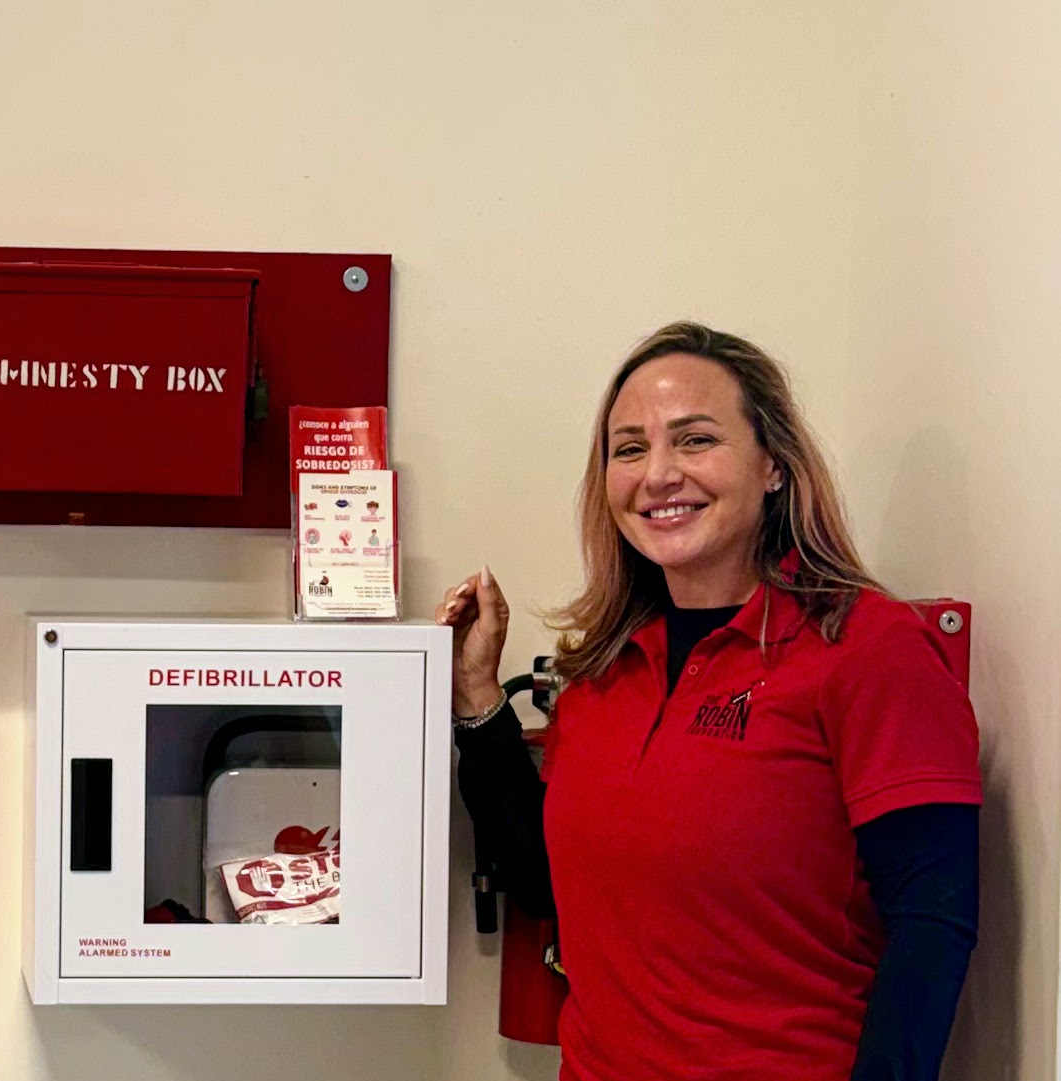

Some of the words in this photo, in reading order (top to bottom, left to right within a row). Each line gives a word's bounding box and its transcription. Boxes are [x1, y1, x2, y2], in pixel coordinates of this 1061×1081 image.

[167, 365, 227, 393] BOX
[313, 433, 330, 444] que
[331, 433, 353, 442] corra
[303, 445, 346, 456] RIESGO
[349, 445, 365, 456] DE
[295, 458, 375, 470] SOBREDOSIS?
[149, 668, 343, 688] DEFIBRILLATOR
[78, 938, 127, 947] WARNING
[78, 948, 129, 957] ALARMED
[130, 948, 171, 957] SYSTEM
